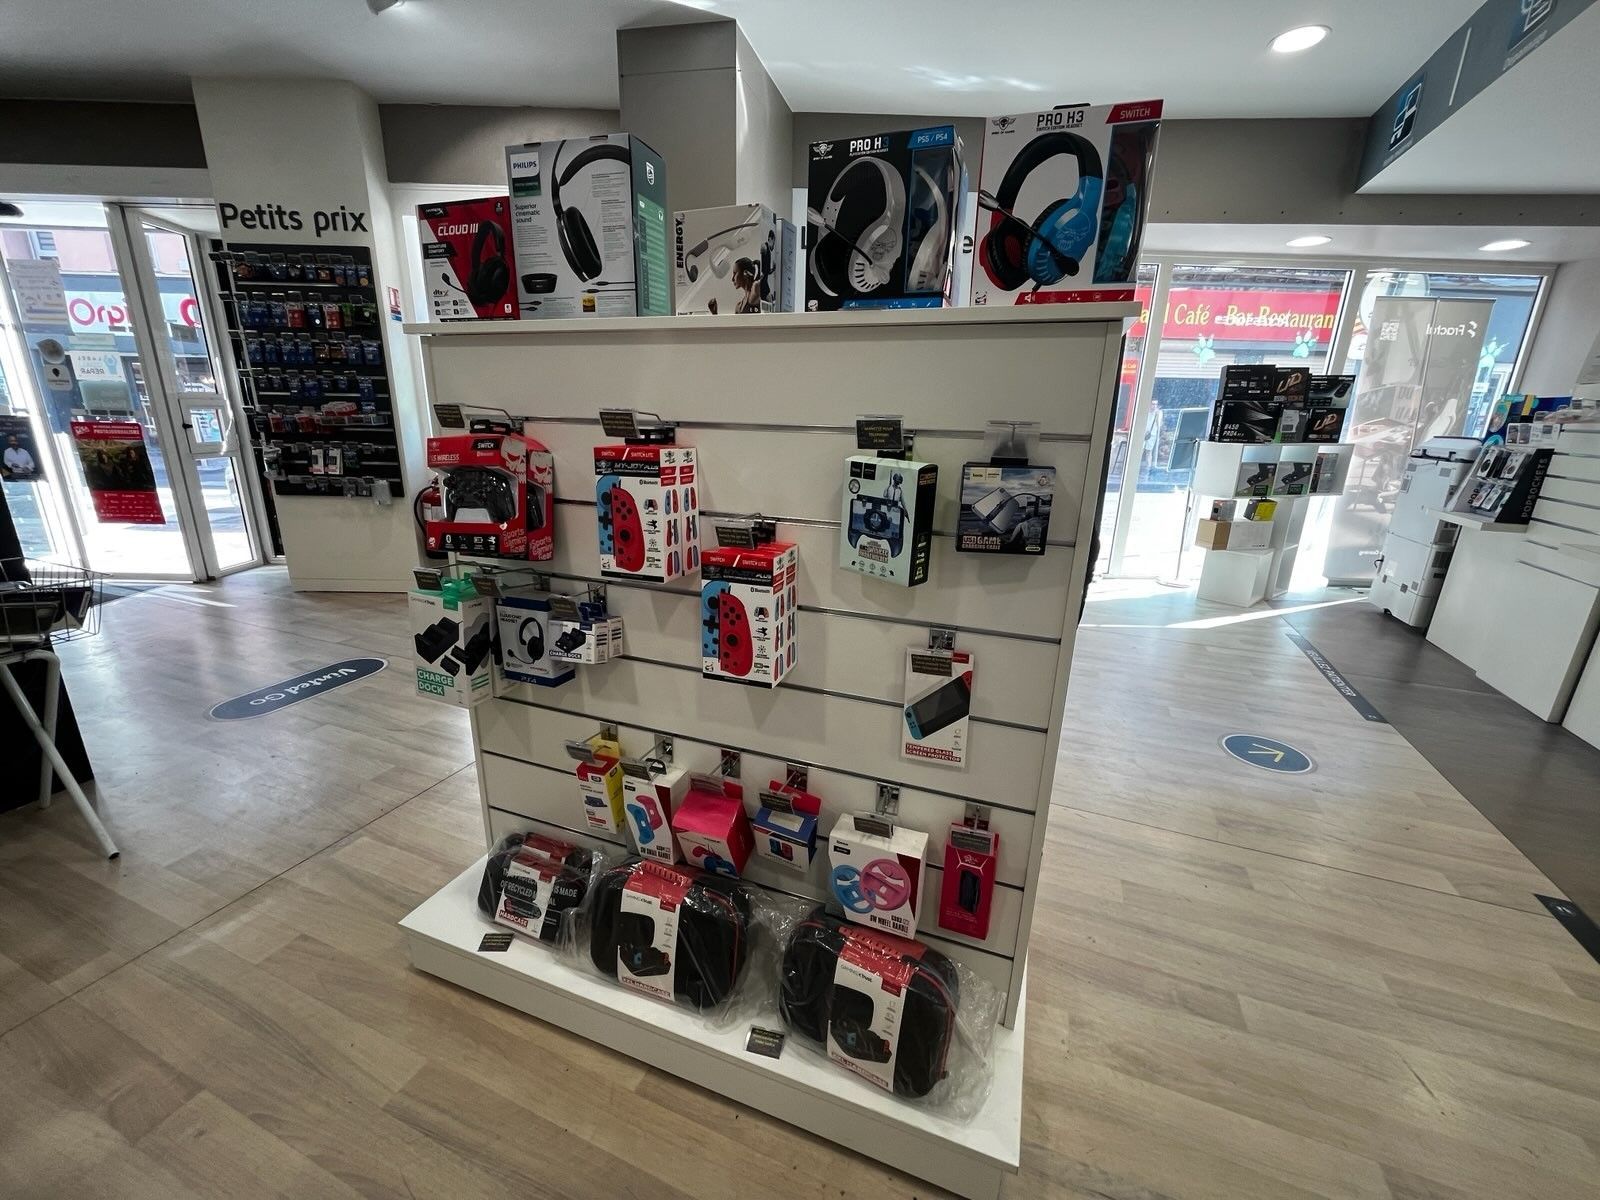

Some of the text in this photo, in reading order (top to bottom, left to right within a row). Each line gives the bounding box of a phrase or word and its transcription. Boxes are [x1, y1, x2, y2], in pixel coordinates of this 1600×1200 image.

[1037, 111, 1085, 127] PRO H3
[1120, 108, 1151, 120] SWITCH
[850, 139, 871, 153] PRO
[918, 135, 930, 143] PS5
[935, 133, 948, 142] PS4
[513, 161, 537, 169] PHILIPS
[219, 202, 369, 238] Petits prix
[437, 223, 479, 237] CLOUD III
[675, 218, 684, 269] ENERGY
[69, 298, 126, 327] Orp
[1174, 303, 1211, 326] Café
[1259, 305, 1337, 329] Restauran
[1521, 458, 1548, 518] POPSOCKETS
[250, 668, 357, 706] Vinted Go
[417, 670, 454, 687] CHARGE
[418, 682, 444, 695] DOCK
[927, 752, 960, 762] PROTECTOR
[508, 881, 533, 898] RECYCLED
[559, 887, 578, 898] MADE
[500, 910, 528, 927] HARDCASE
